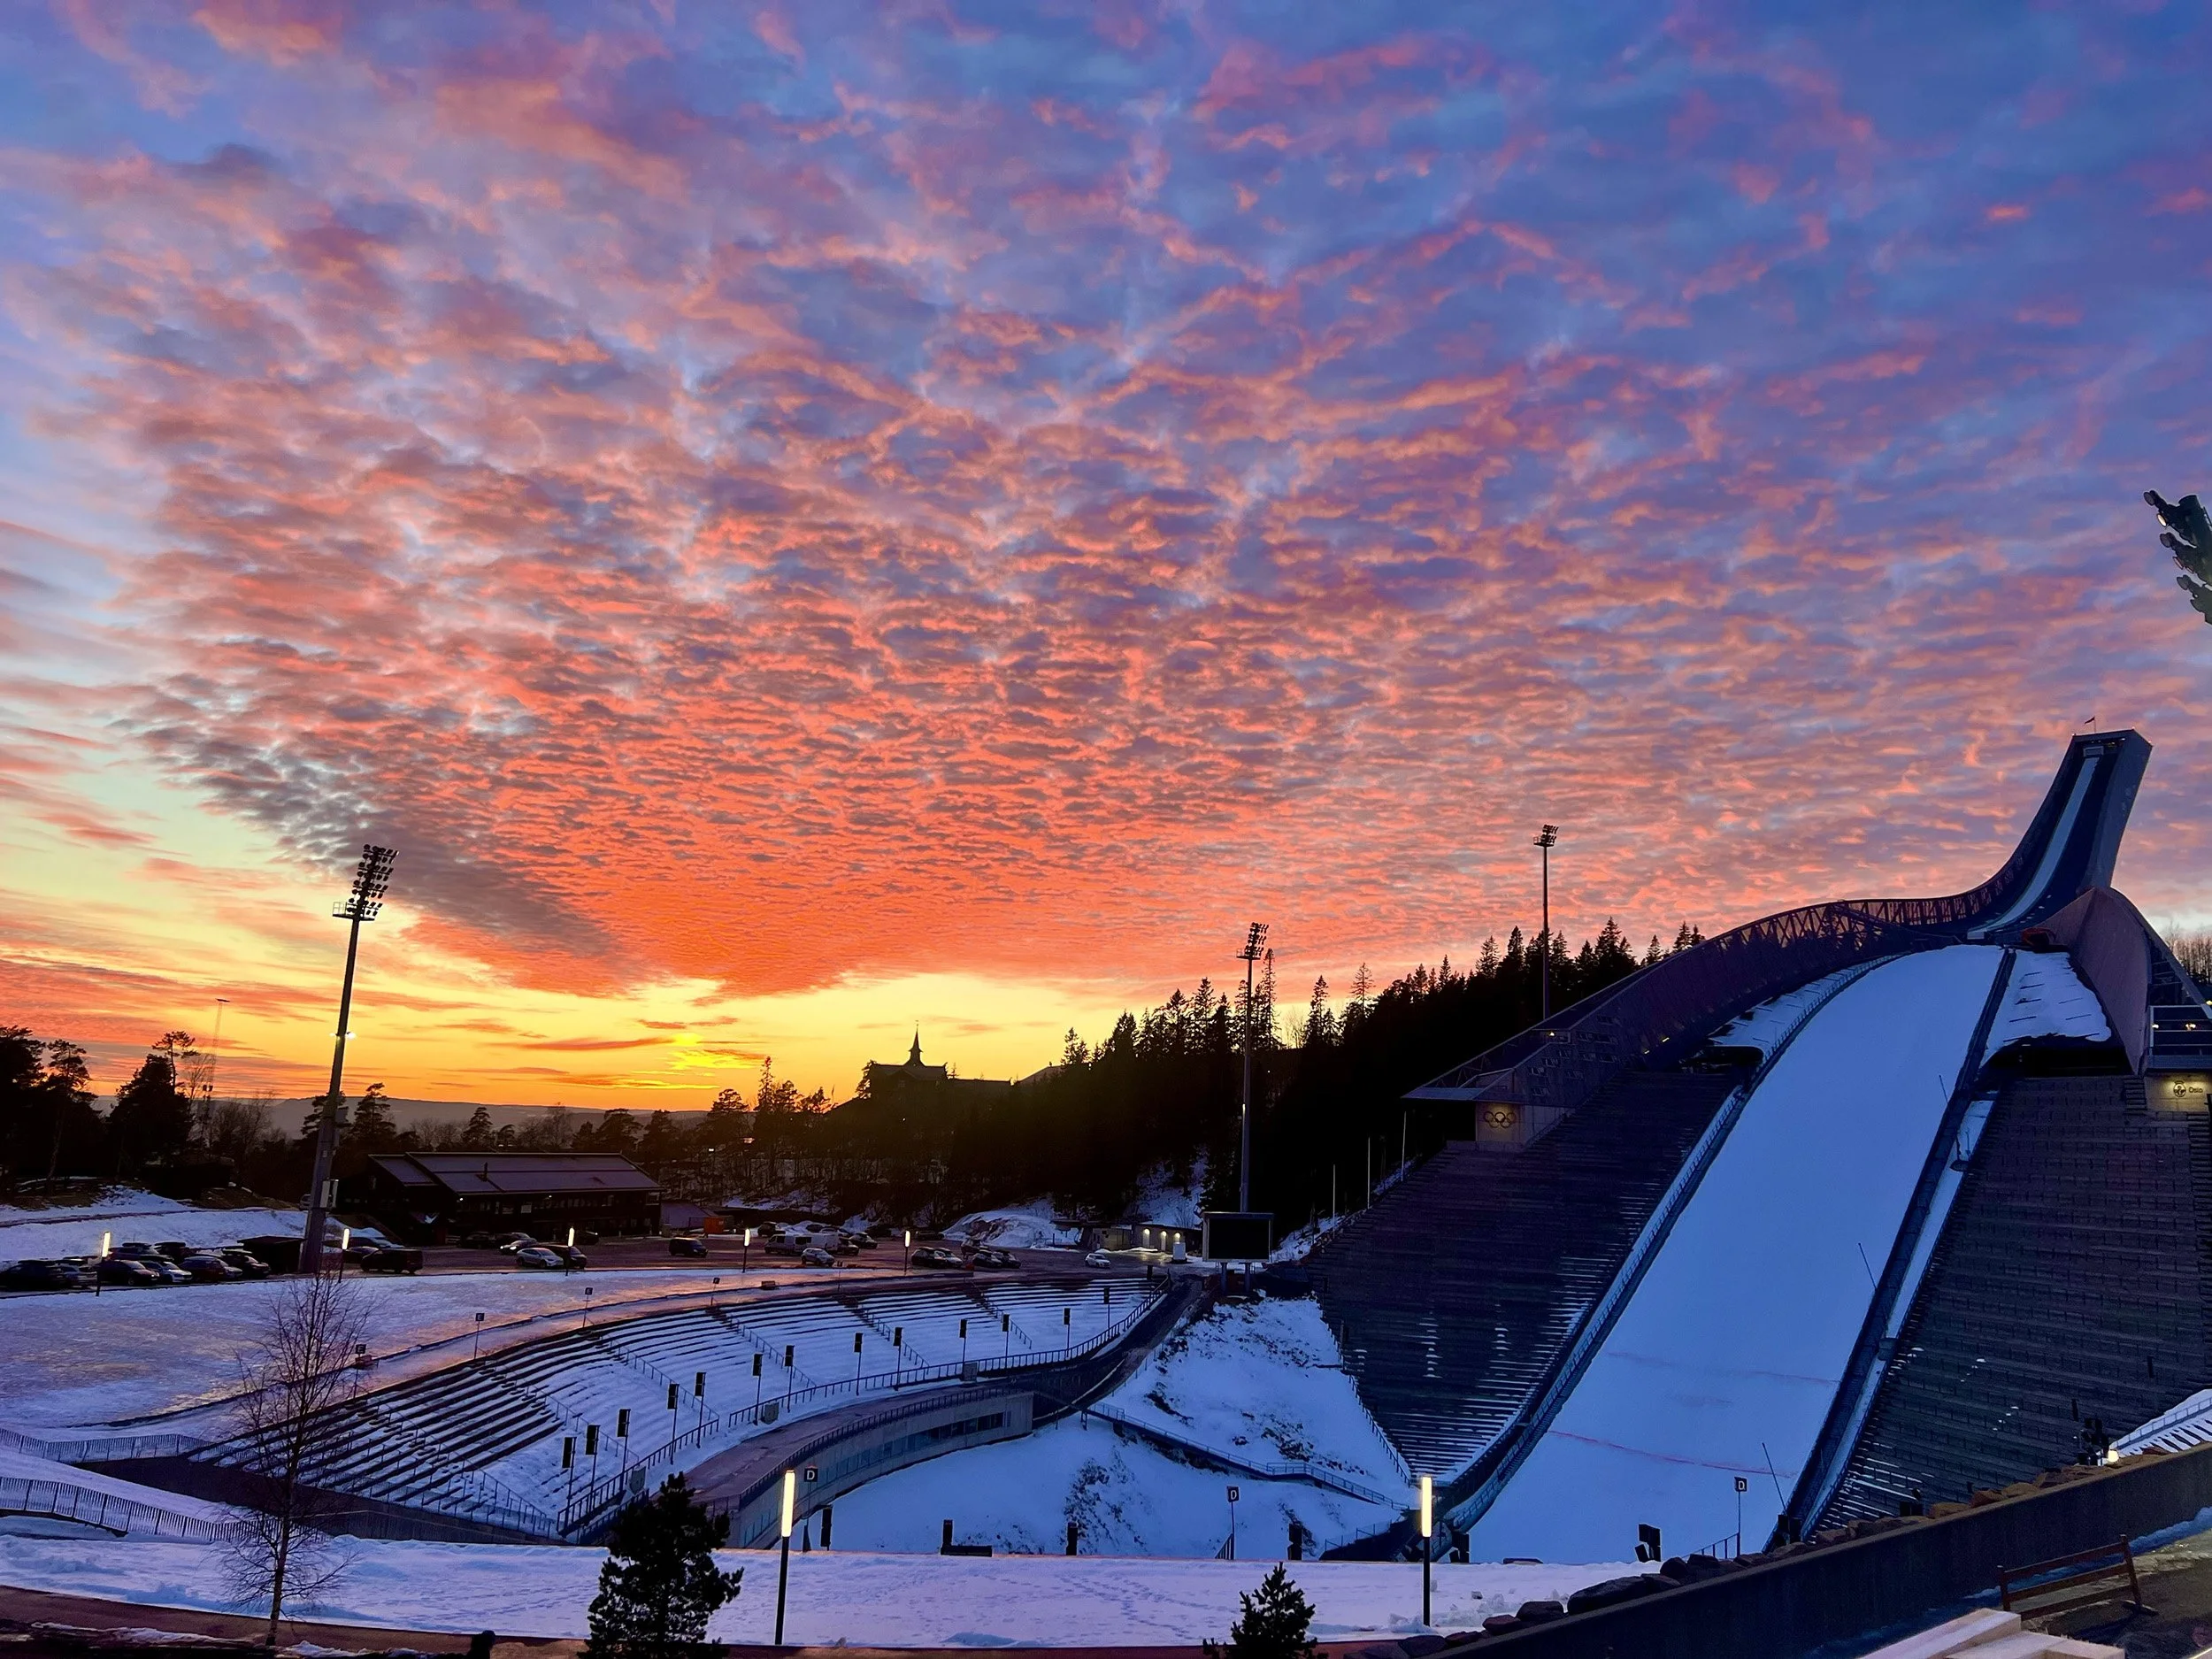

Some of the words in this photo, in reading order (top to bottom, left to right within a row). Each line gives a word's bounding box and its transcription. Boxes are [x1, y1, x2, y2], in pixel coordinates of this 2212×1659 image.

[807, 1470, 815, 1480] D
[1739, 1480, 1746, 1490] D
[1231, 1490, 1237, 1500] D
